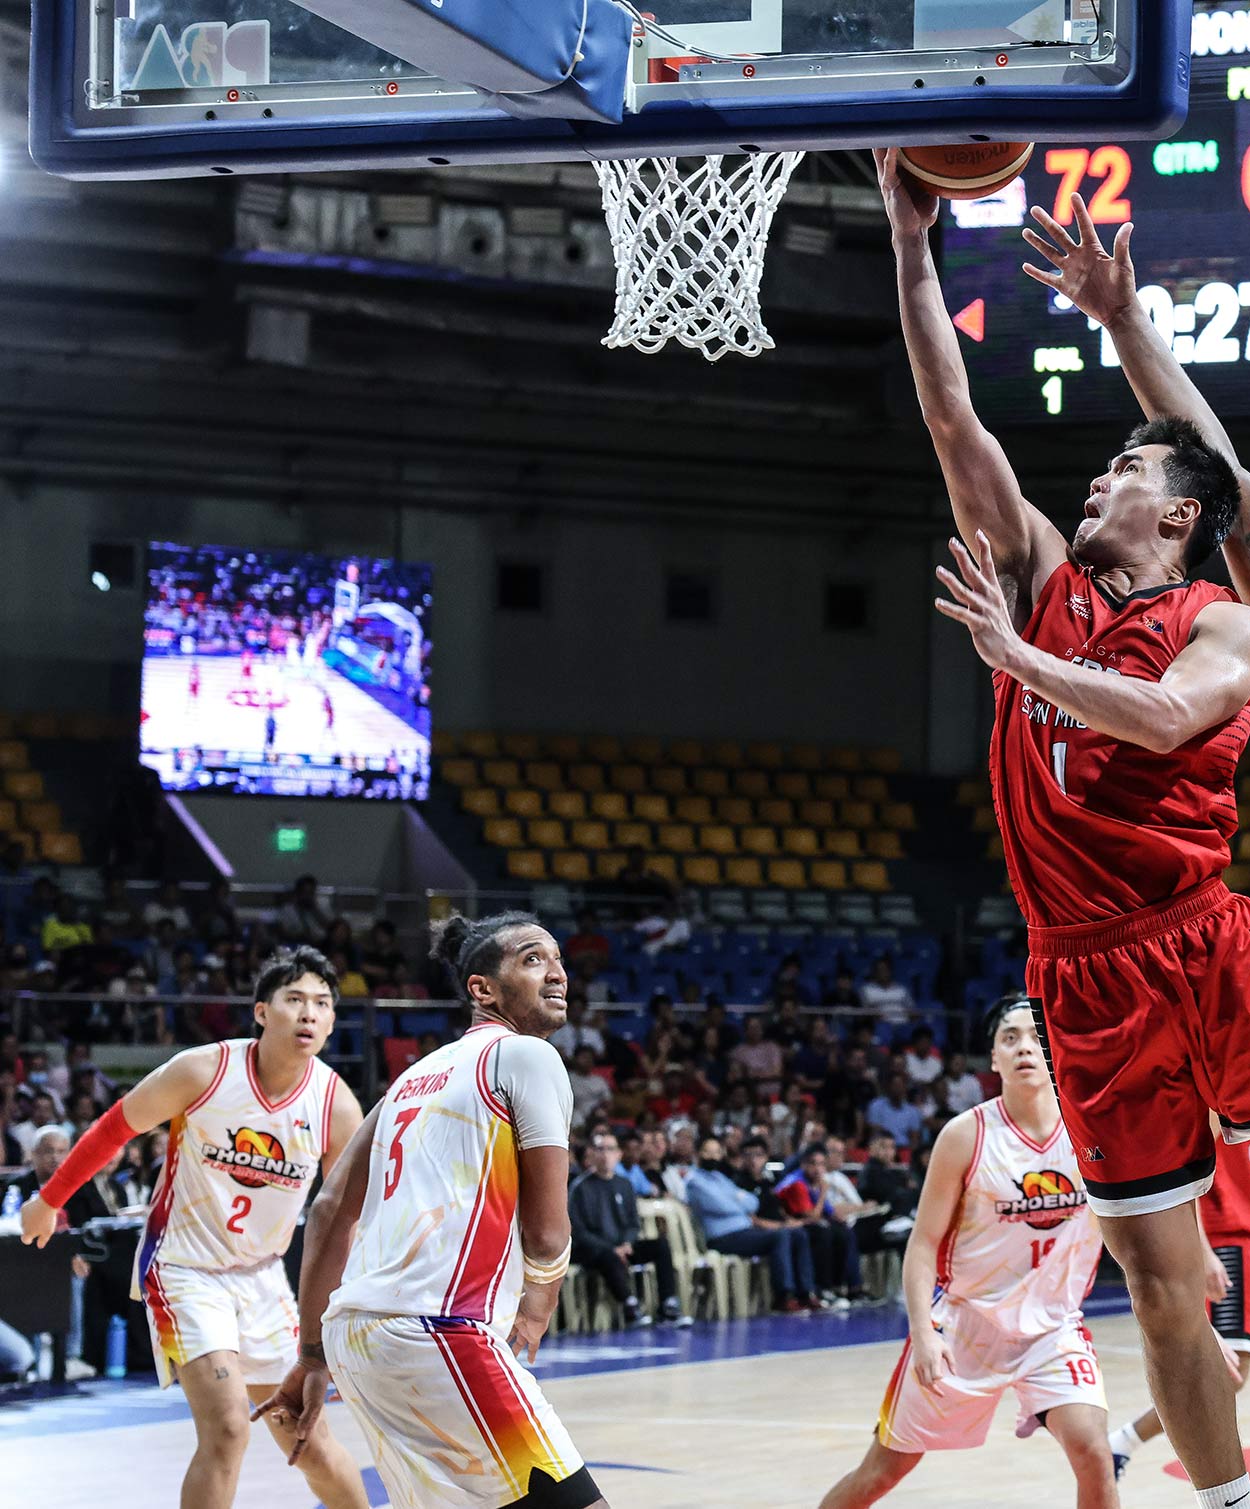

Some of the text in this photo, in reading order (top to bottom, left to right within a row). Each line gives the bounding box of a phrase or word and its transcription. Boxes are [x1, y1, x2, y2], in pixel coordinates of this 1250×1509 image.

[1045, 146, 1132, 226] 72
[1041, 376, 1062, 414] 1
[1021, 694, 1050, 725] SAN
[1053, 742, 1067, 796] 1
[394, 1066, 455, 1103] PERKINS
[201, 1142, 309, 1180] PHOENIX
[384, 1107, 422, 1201] 3
[226, 1194, 252, 1234] 2
[1065, 1358, 1096, 1386] 19
